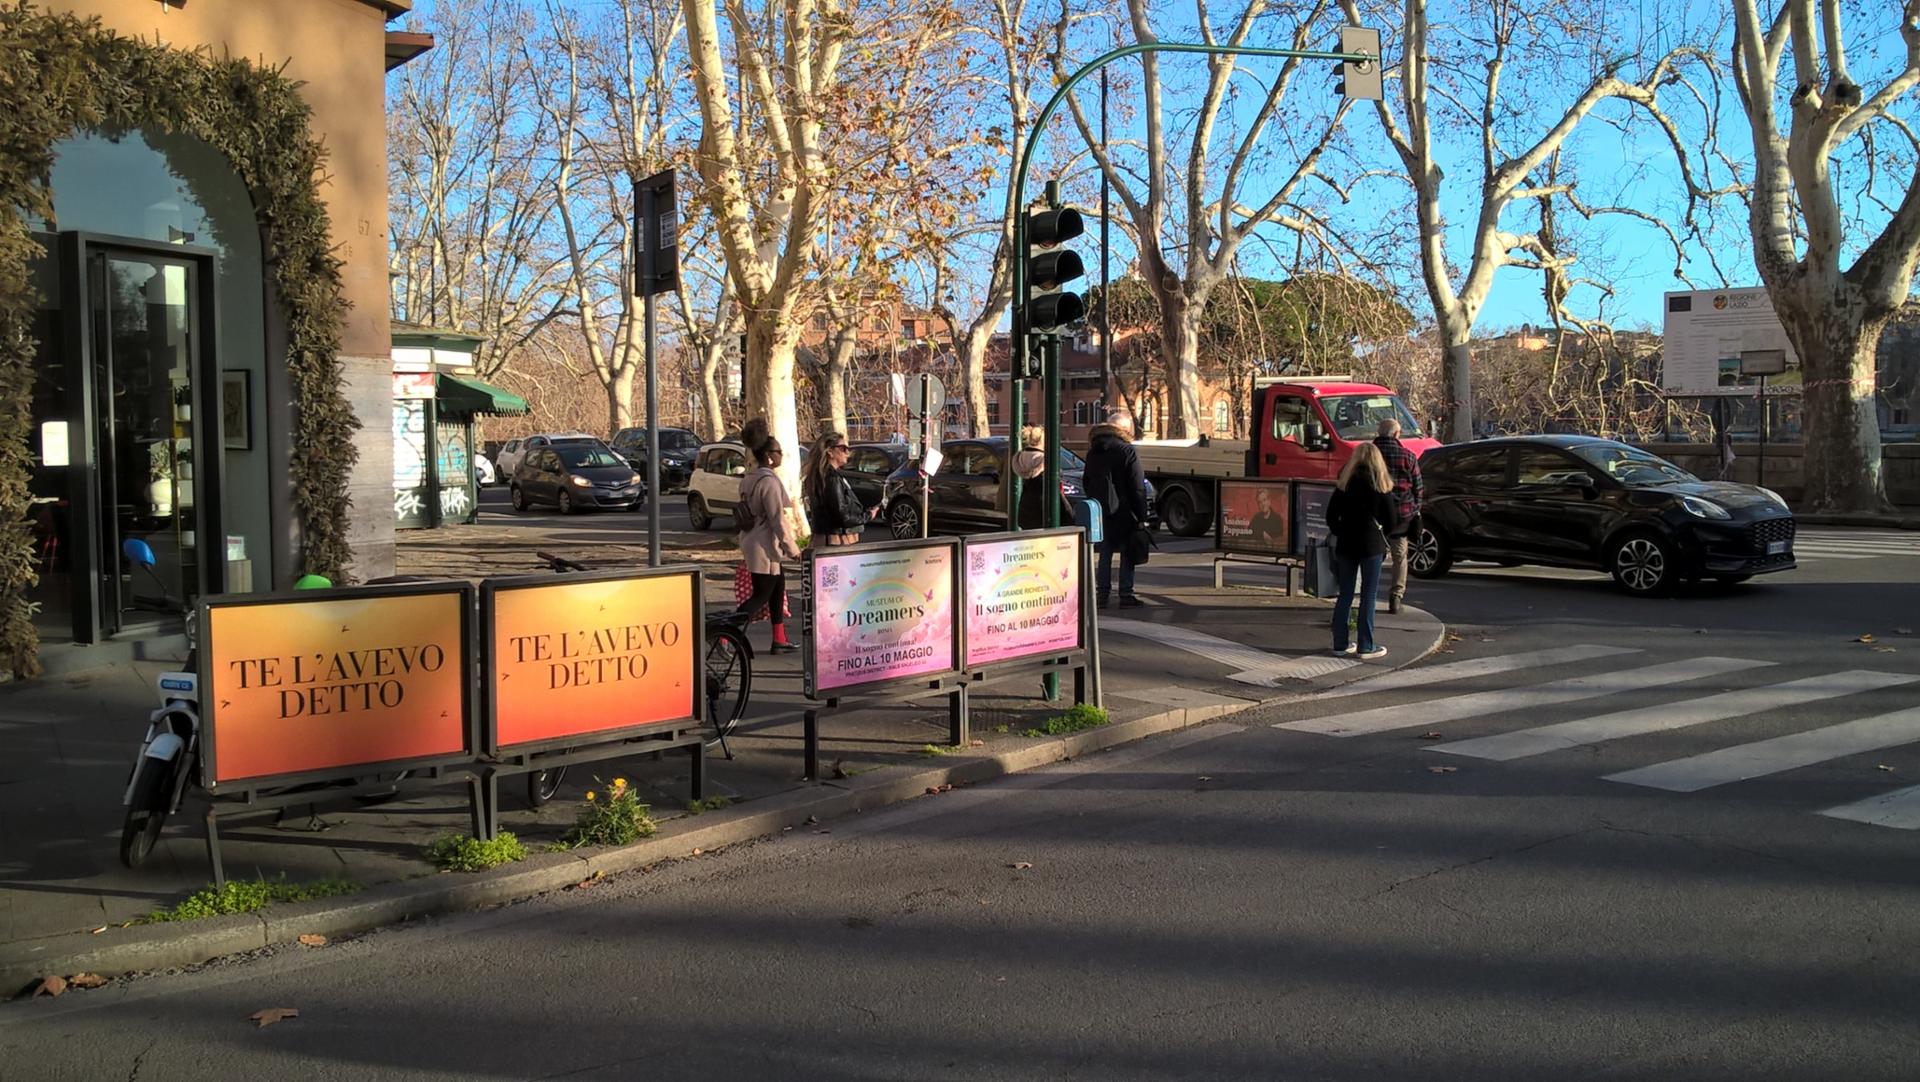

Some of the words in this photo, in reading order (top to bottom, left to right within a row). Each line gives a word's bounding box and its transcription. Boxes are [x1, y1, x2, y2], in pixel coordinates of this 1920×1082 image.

[1223, 525, 1253, 537] Pappano
[1002, 551, 1046, 564] Dreamers
[866, 597, 896, 608] MUSEUM
[895, 596, 905, 604] OF
[1001, 588, 1023, 597] GRANDE
[1024, 585, 1050, 594] RICHIESTA
[975, 604, 983, 616] Il
[986, 602, 1018, 615] sogno
[1020, 591, 1068, 610] continua!
[846, 604, 925, 627] Dreamers
[987, 623, 1006, 635] FINO
[1007, 621, 1018, 631] AL
[1019, 620, 1029, 629] 10
[1029, 614, 1060, 627] MAGGIO
[510, 634, 553, 664] TE
[560, 621, 680, 659] L'AVEVO
[862, 643, 884, 655] sogno
[230, 656, 282, 690] TE
[290, 644, 445, 685] L'AVEVO
[837, 659, 863, 672] FINO
[864, 656, 878, 668] AL
[879, 652, 891, 665] 10
[893, 646, 933, 662] MAGGIO
[548, 653, 649, 690] DETTO
[277, 679, 404, 720] DETTO
